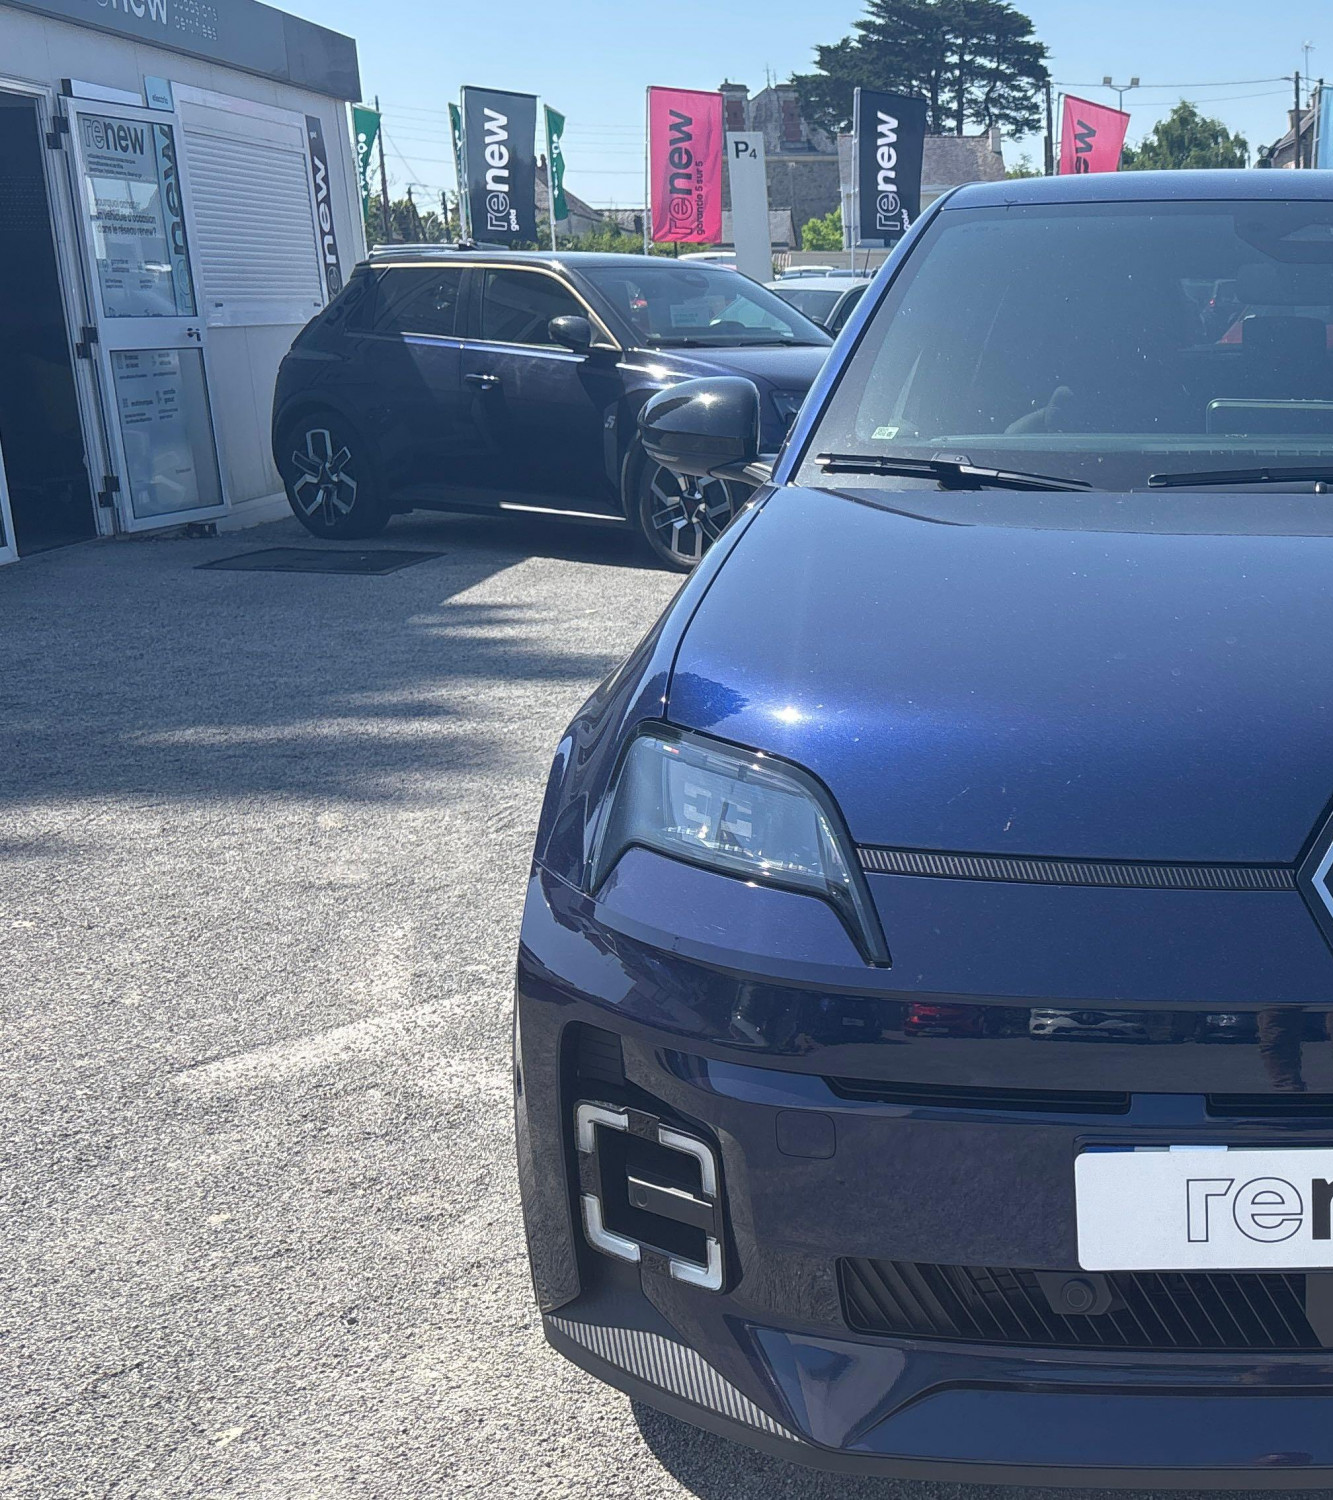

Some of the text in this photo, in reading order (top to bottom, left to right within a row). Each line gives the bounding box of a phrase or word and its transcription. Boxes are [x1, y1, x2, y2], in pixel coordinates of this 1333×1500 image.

[83, 118, 144, 155] renew
[483, 107, 510, 231] renew
[668, 109, 693, 236] renew
[877, 110, 901, 231] renew
[314, 155, 342, 300] enew
[510, 209, 520, 232] gold
